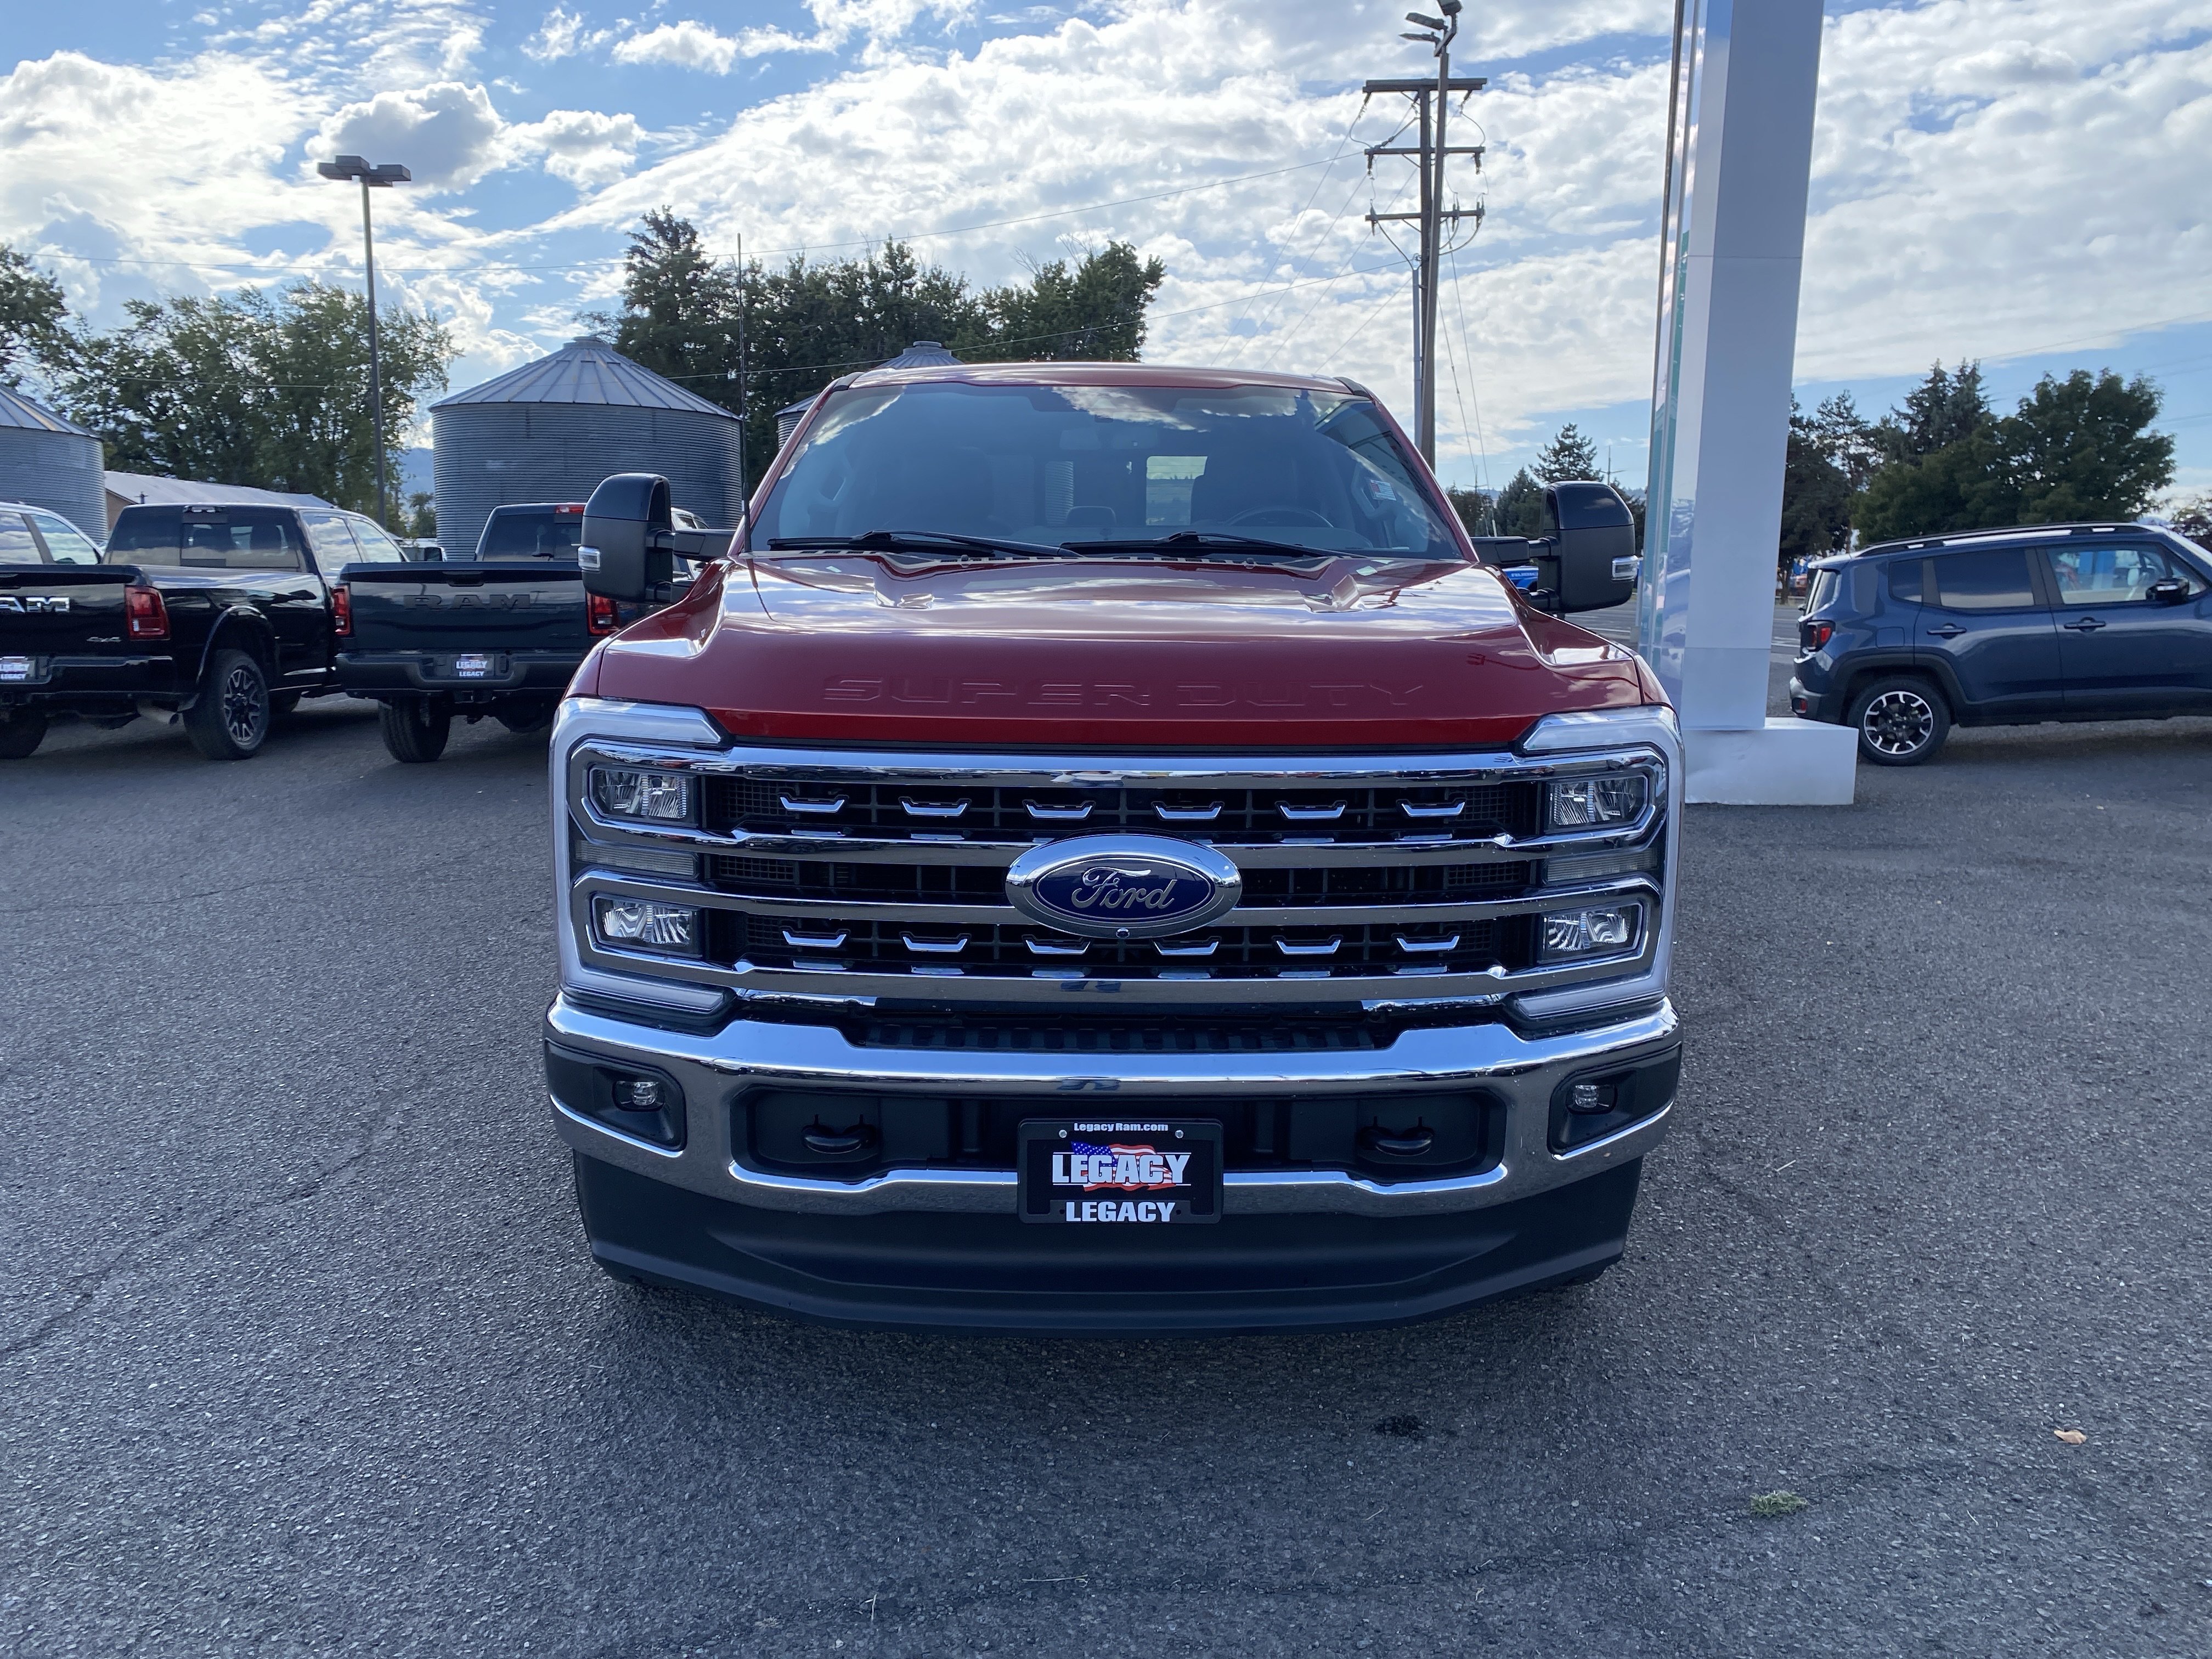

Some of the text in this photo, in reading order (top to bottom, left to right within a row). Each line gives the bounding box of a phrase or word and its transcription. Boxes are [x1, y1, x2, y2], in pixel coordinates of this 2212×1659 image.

[0, 596, 70, 613] AM
[403, 594, 531, 610] RAM
[456, 661, 488, 669] LEGACY
[822, 675, 1424, 706] SUPER DUTY
[1071, 866, 1178, 910] Ford
[1052, 1154, 1190, 1184] LEGACY
[1065, 1201, 1176, 1222] LEGACY
